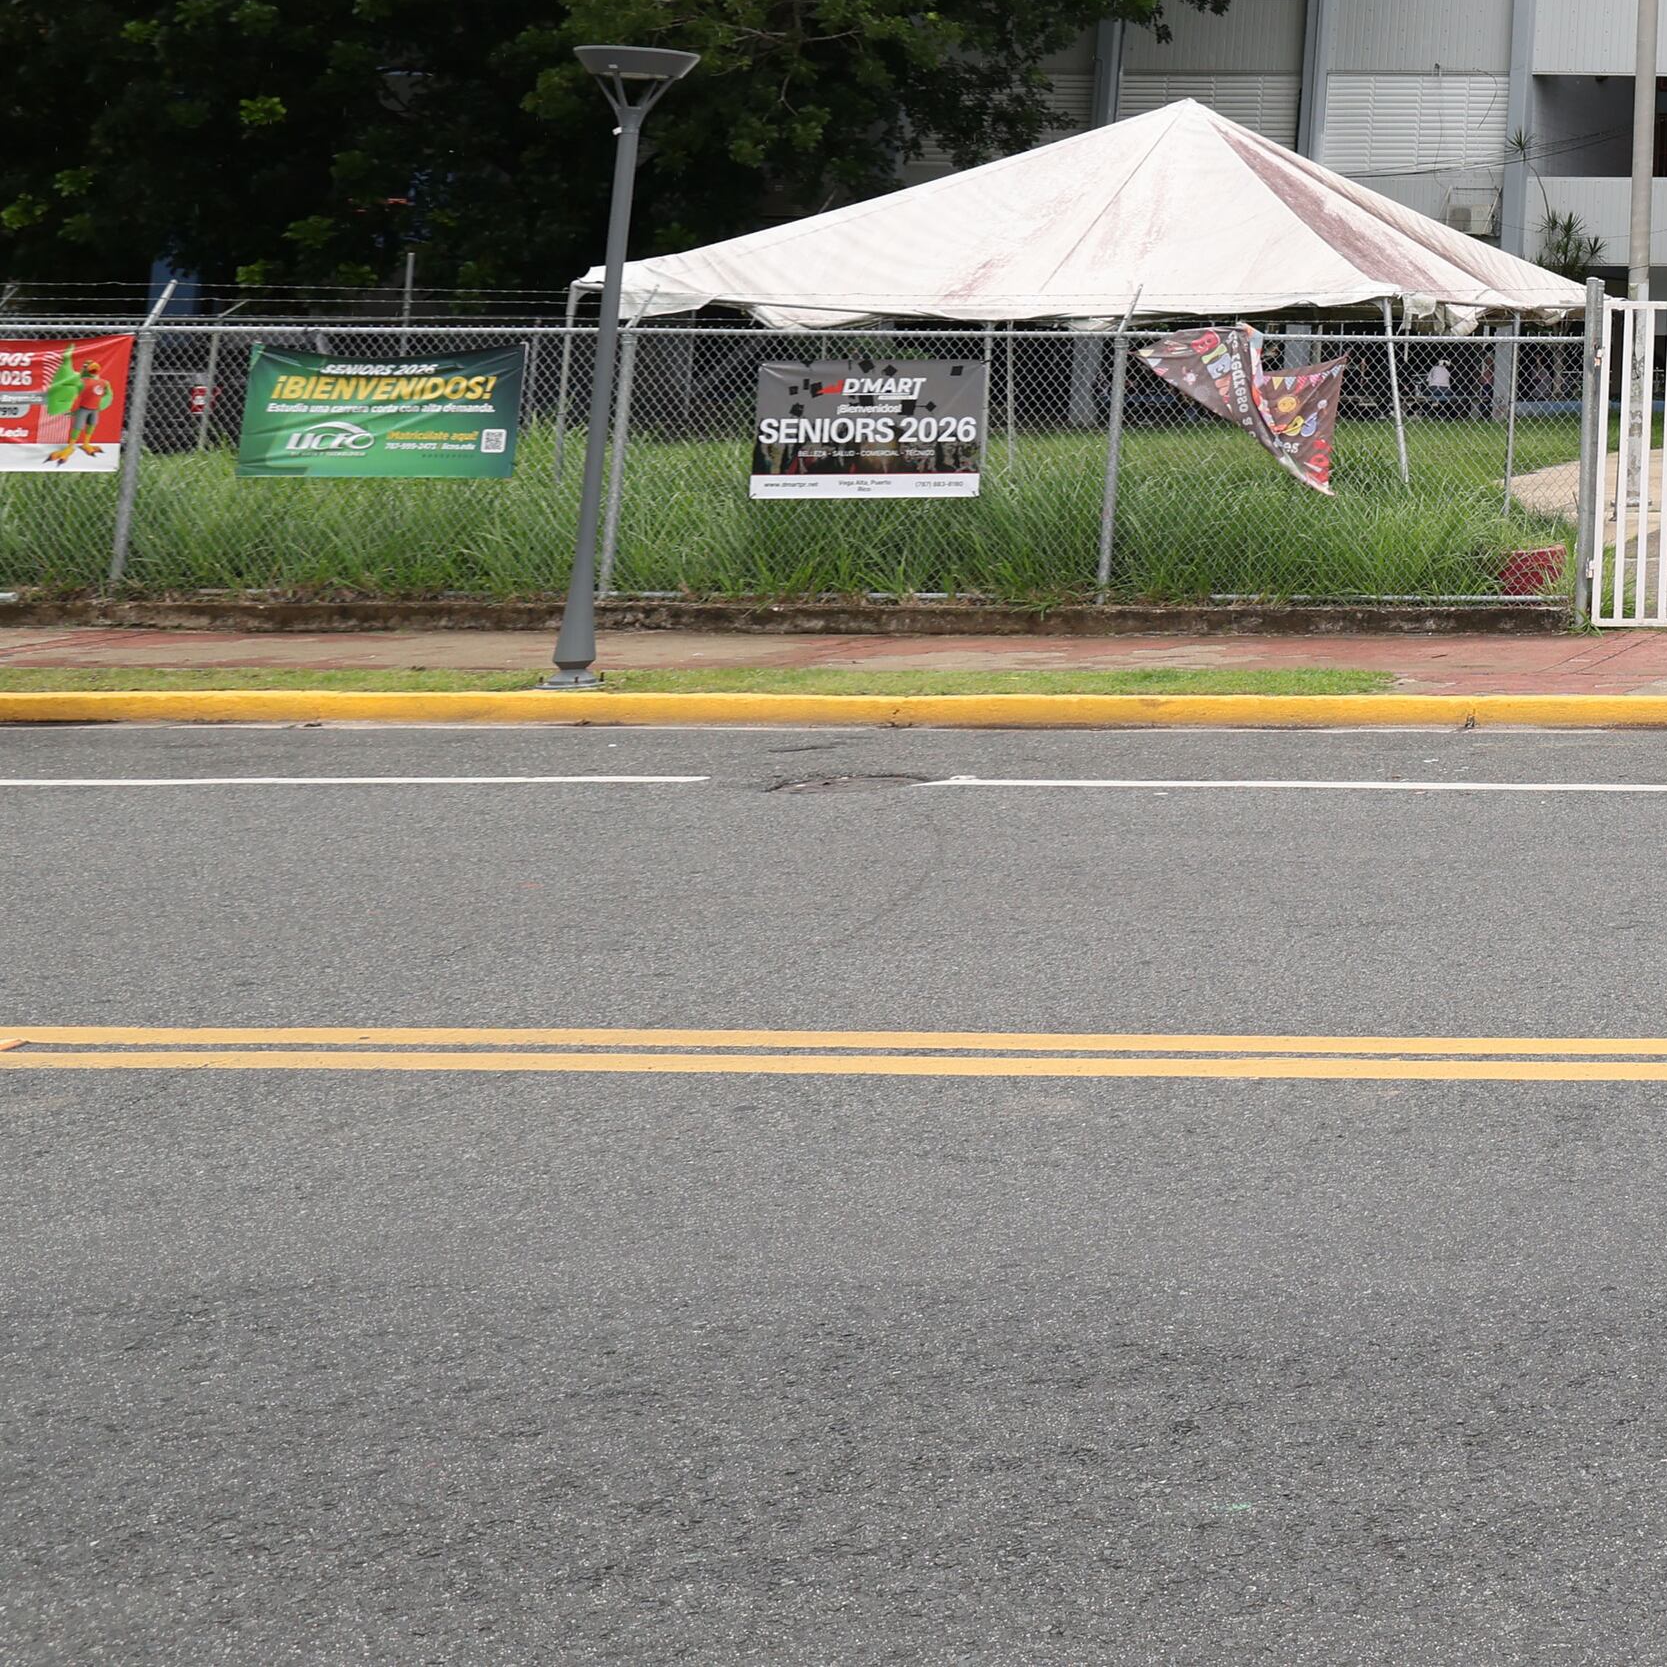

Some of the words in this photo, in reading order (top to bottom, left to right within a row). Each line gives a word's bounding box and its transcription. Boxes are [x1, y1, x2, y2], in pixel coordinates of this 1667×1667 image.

[320, 364, 396, 375] SENIORS
[394, 364, 438, 374] 2026
[271, 375, 497, 401] ¡BIENVENIDOS!
[842, 378, 927, 400] D'MART
[266, 403, 308, 412] Estudia
[836, 404, 903, 415] ¡Bienvenidos!
[758, 418, 895, 443] SENIORS
[898, 417, 977, 443] 2026
